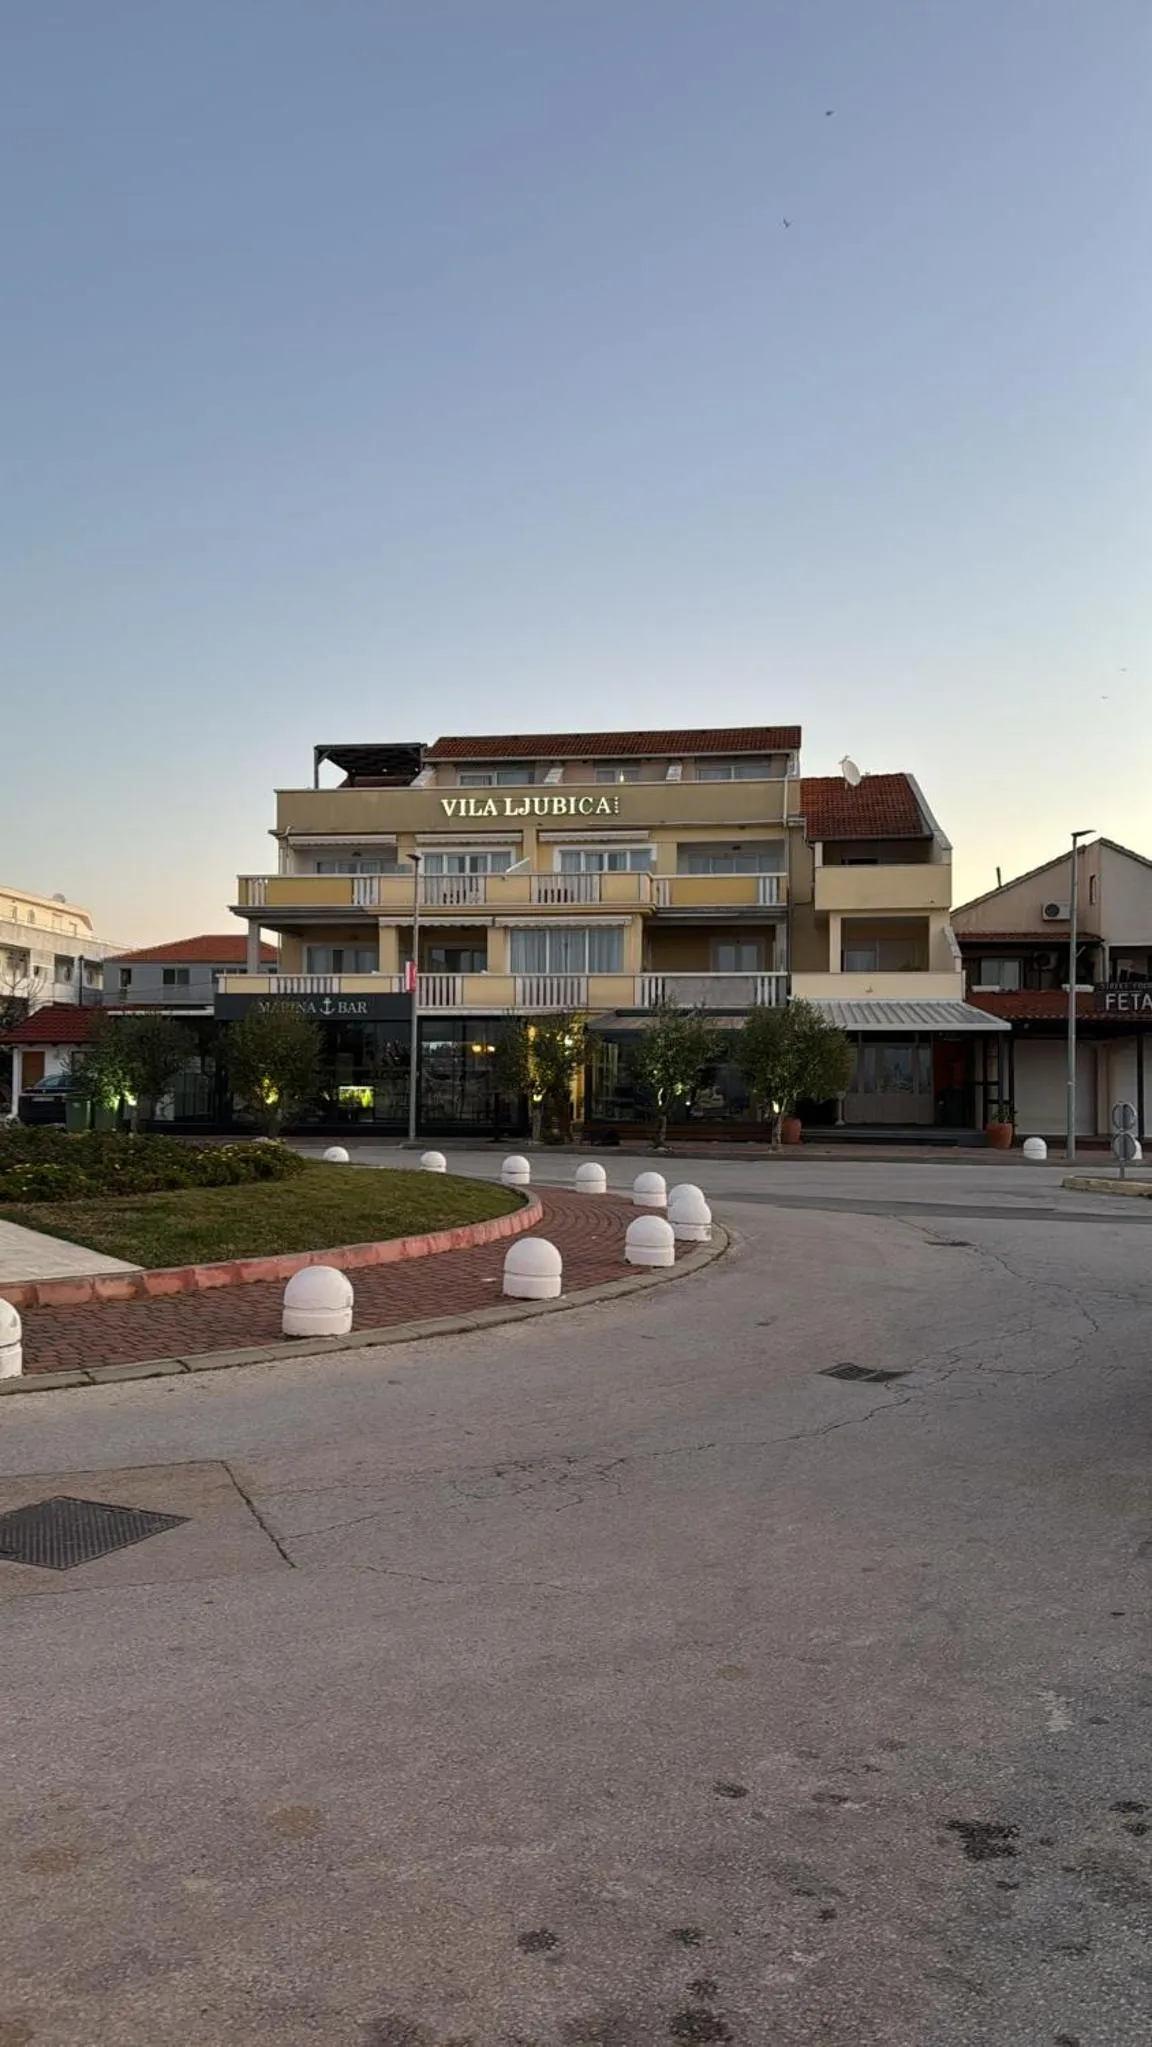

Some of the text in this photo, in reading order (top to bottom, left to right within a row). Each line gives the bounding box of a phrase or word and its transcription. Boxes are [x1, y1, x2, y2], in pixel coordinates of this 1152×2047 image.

[441, 796, 611, 817] VILA LJUBICA
[337, 1001, 368, 1014] BAR
